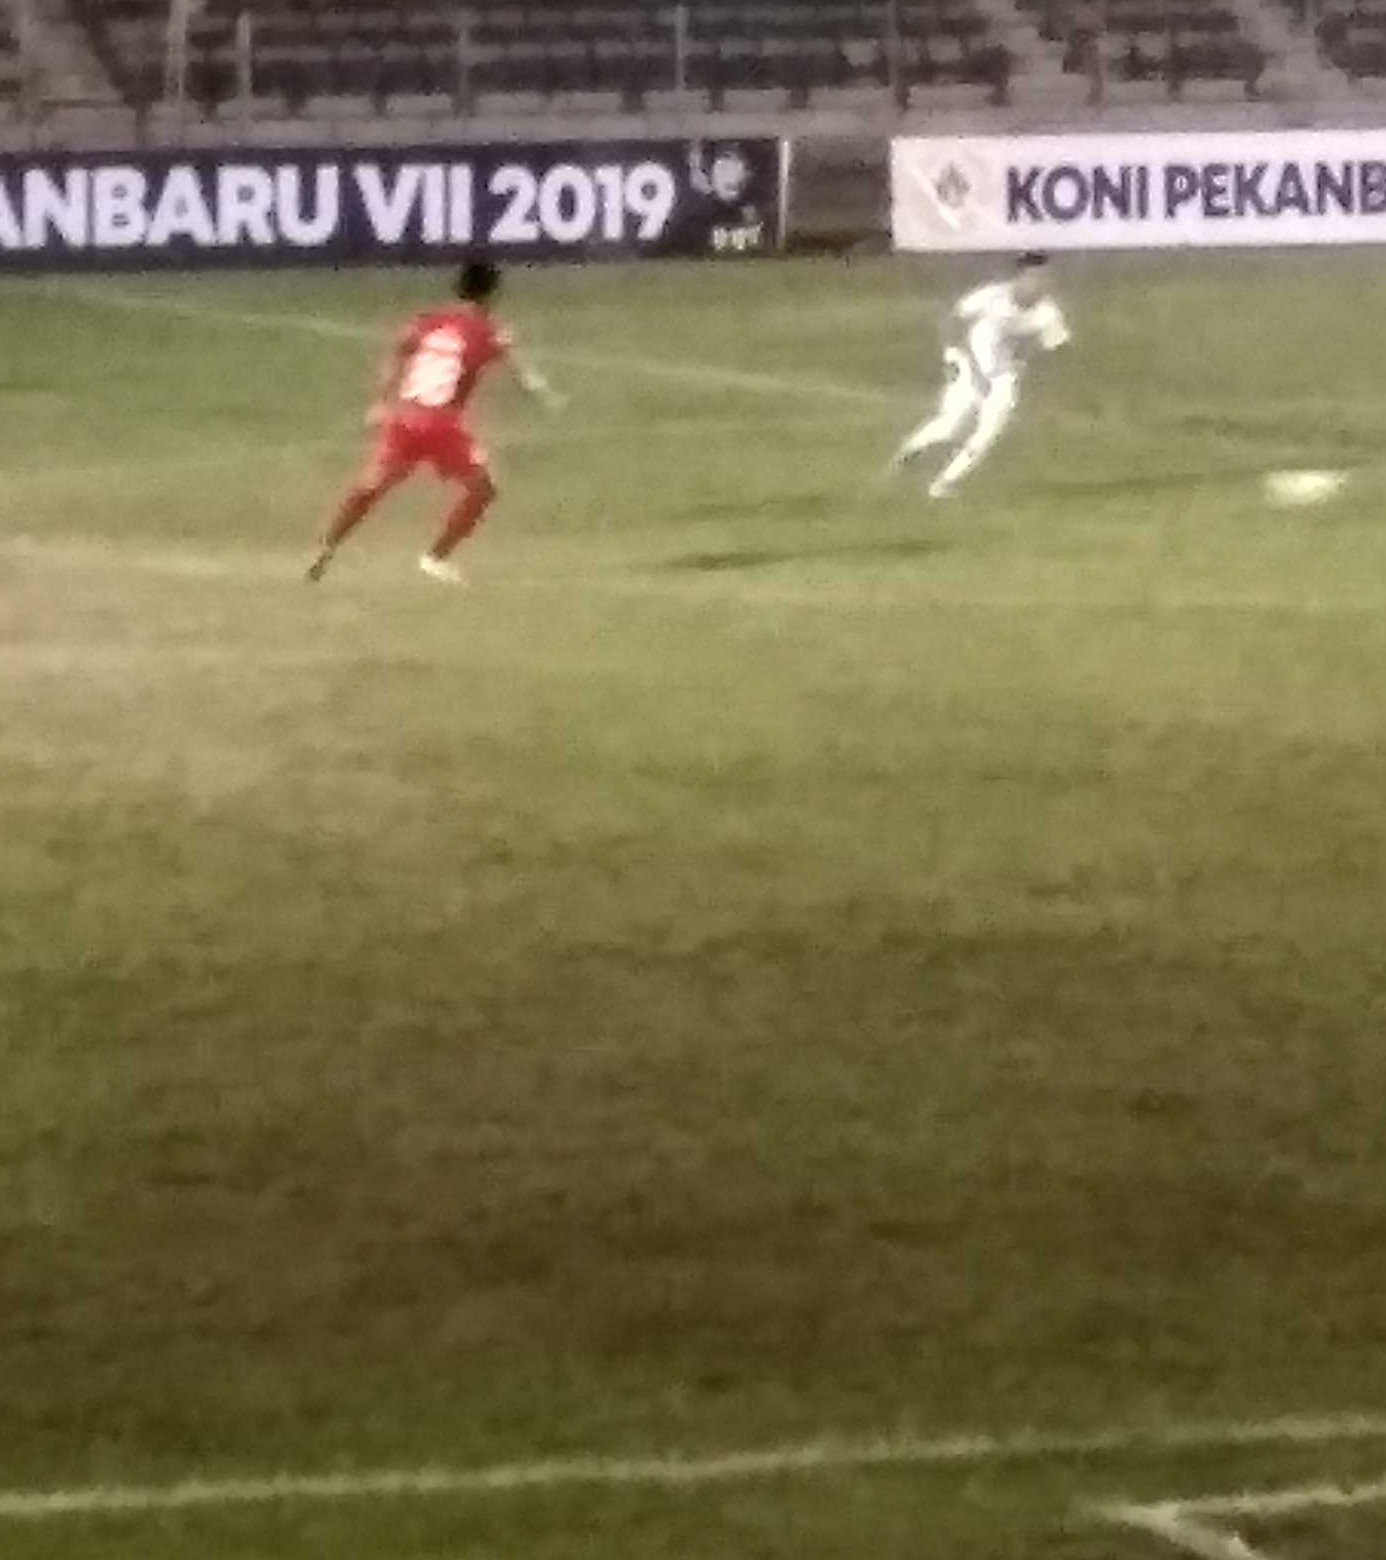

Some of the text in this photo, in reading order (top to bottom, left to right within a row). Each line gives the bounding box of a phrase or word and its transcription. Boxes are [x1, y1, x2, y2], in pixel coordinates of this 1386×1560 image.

[354, 160, 472, 244] VII
[489, 159, 676, 243] 2019
[1006, 164, 1150, 223] KONI
